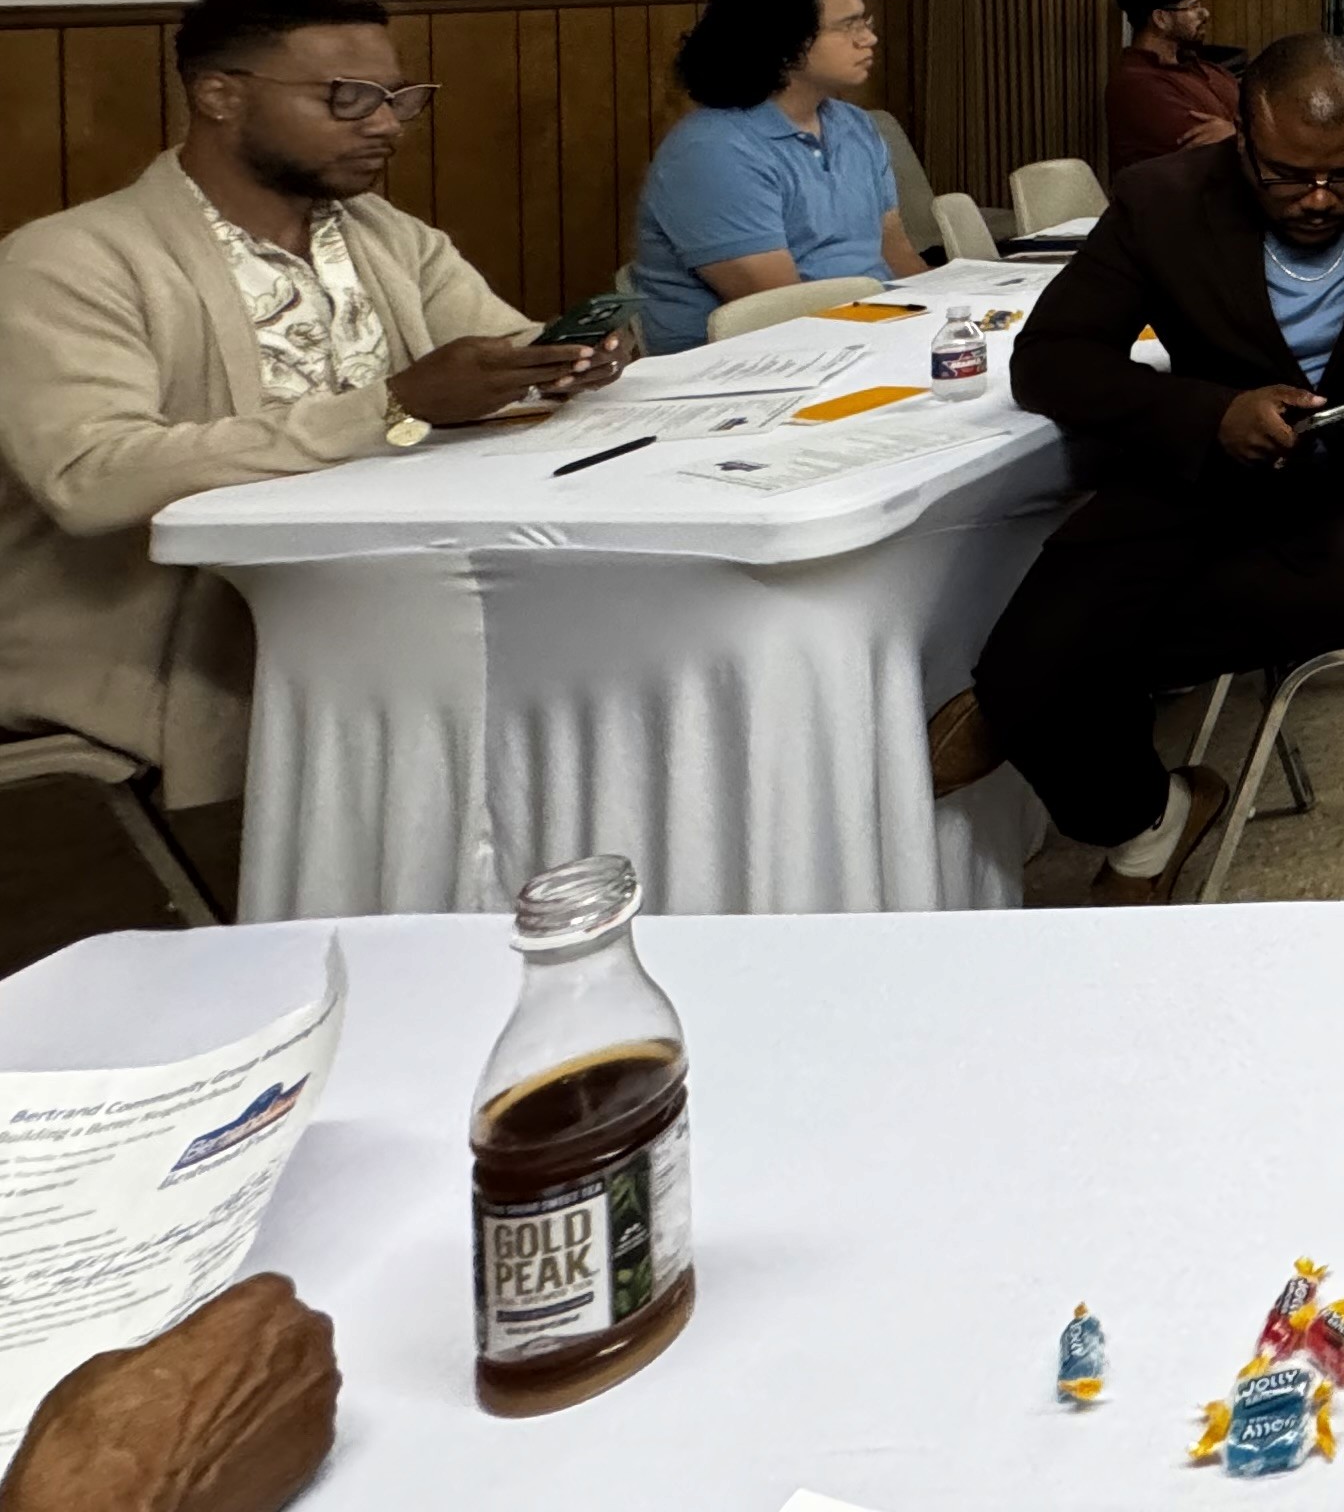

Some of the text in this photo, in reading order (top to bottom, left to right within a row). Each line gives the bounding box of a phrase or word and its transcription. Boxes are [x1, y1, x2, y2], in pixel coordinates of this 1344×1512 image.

[10, 1102, 105, 1124] Bertrand
[494, 1208, 593, 1260] GOLD
[495, 1244, 593, 1299] PEAK
[1240, 1369, 1299, 1397] JOLLY
